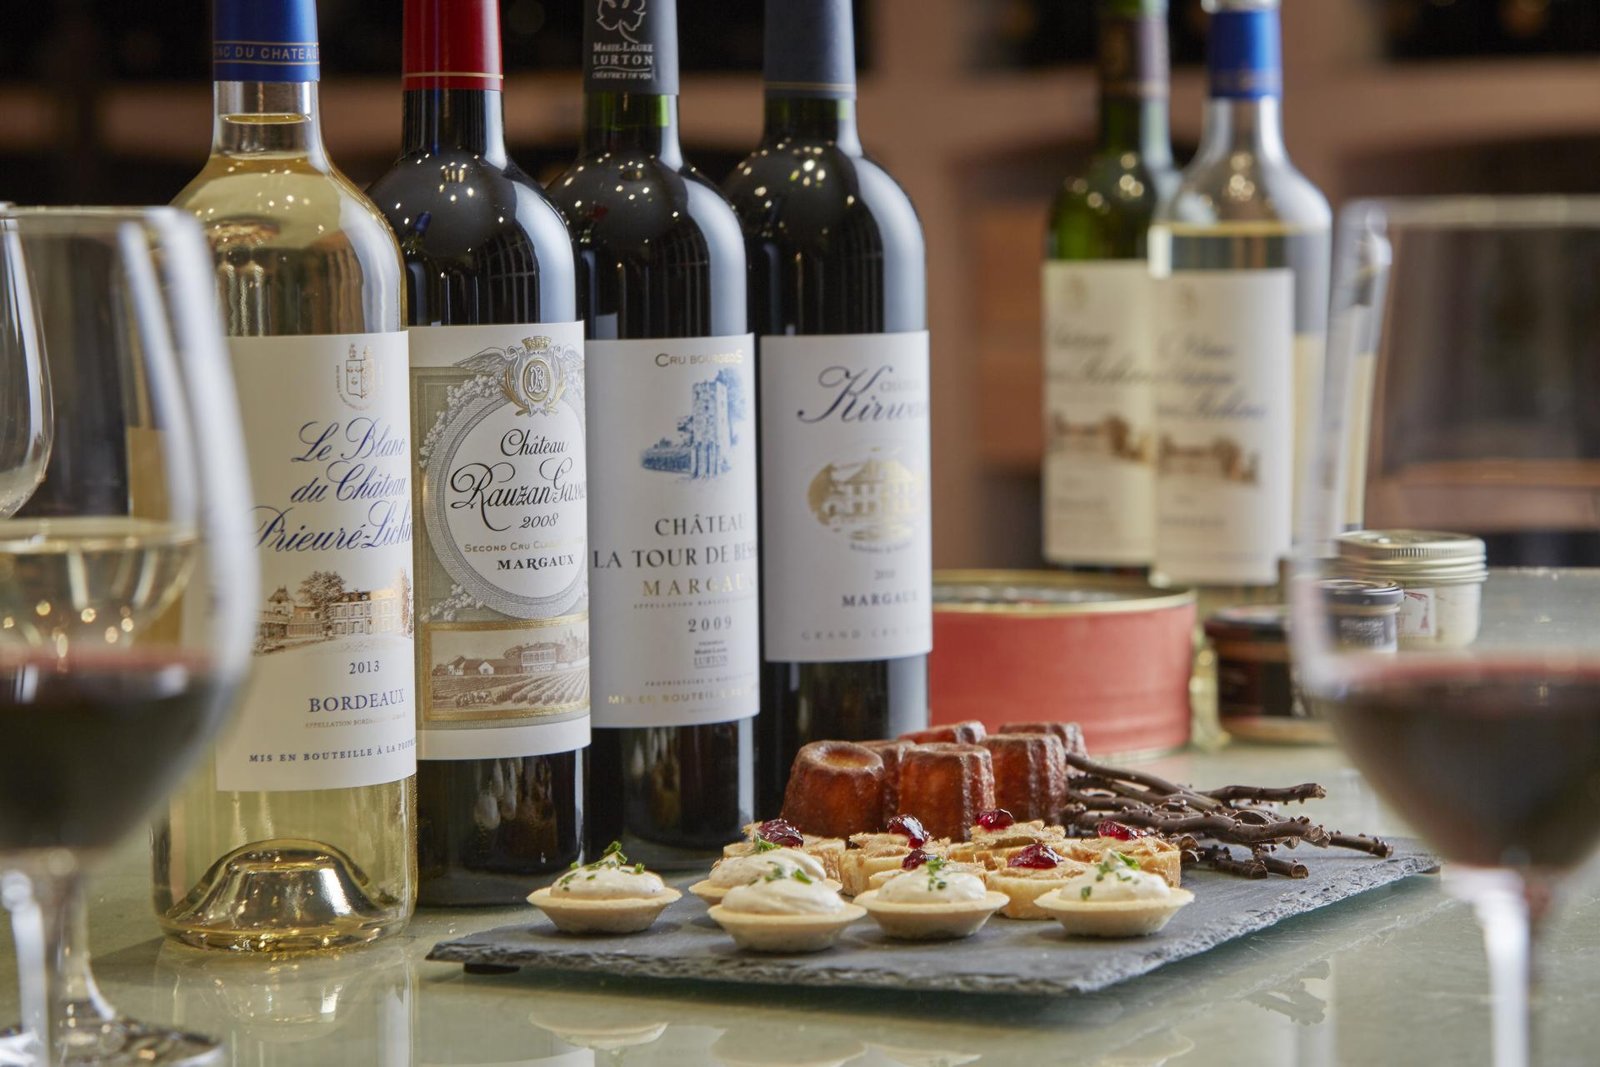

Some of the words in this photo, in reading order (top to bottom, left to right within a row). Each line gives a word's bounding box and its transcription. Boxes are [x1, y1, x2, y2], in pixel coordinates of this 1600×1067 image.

[235, 46, 254, 58] DU
[593, 54, 653, 65] LURTON
[655, 353, 687, 368] CRU
[291, 420, 340, 462] Le
[340, 416, 405, 460] Blanc
[501, 428, 568, 457] Château
[290, 477, 328, 503] du
[519, 513, 559, 529] 2008
[464, 542, 507, 553] SECOND
[510, 541, 530, 551] CRU
[497, 554, 574, 571] MARGAUX
[593, 550, 622, 569] LA
[632, 547, 698, 568] TOUR
[706, 544, 729, 565] DE
[688, 616, 732, 632] 2009
[349, 660, 380, 674] 2013
[308, 688, 405, 713] BORDEAUX
[249, 754, 273, 762] MIS
[280, 753, 296, 762] EN
[303, 747, 373, 761] BOUTEILLE
[386, 745, 395, 753] LA
